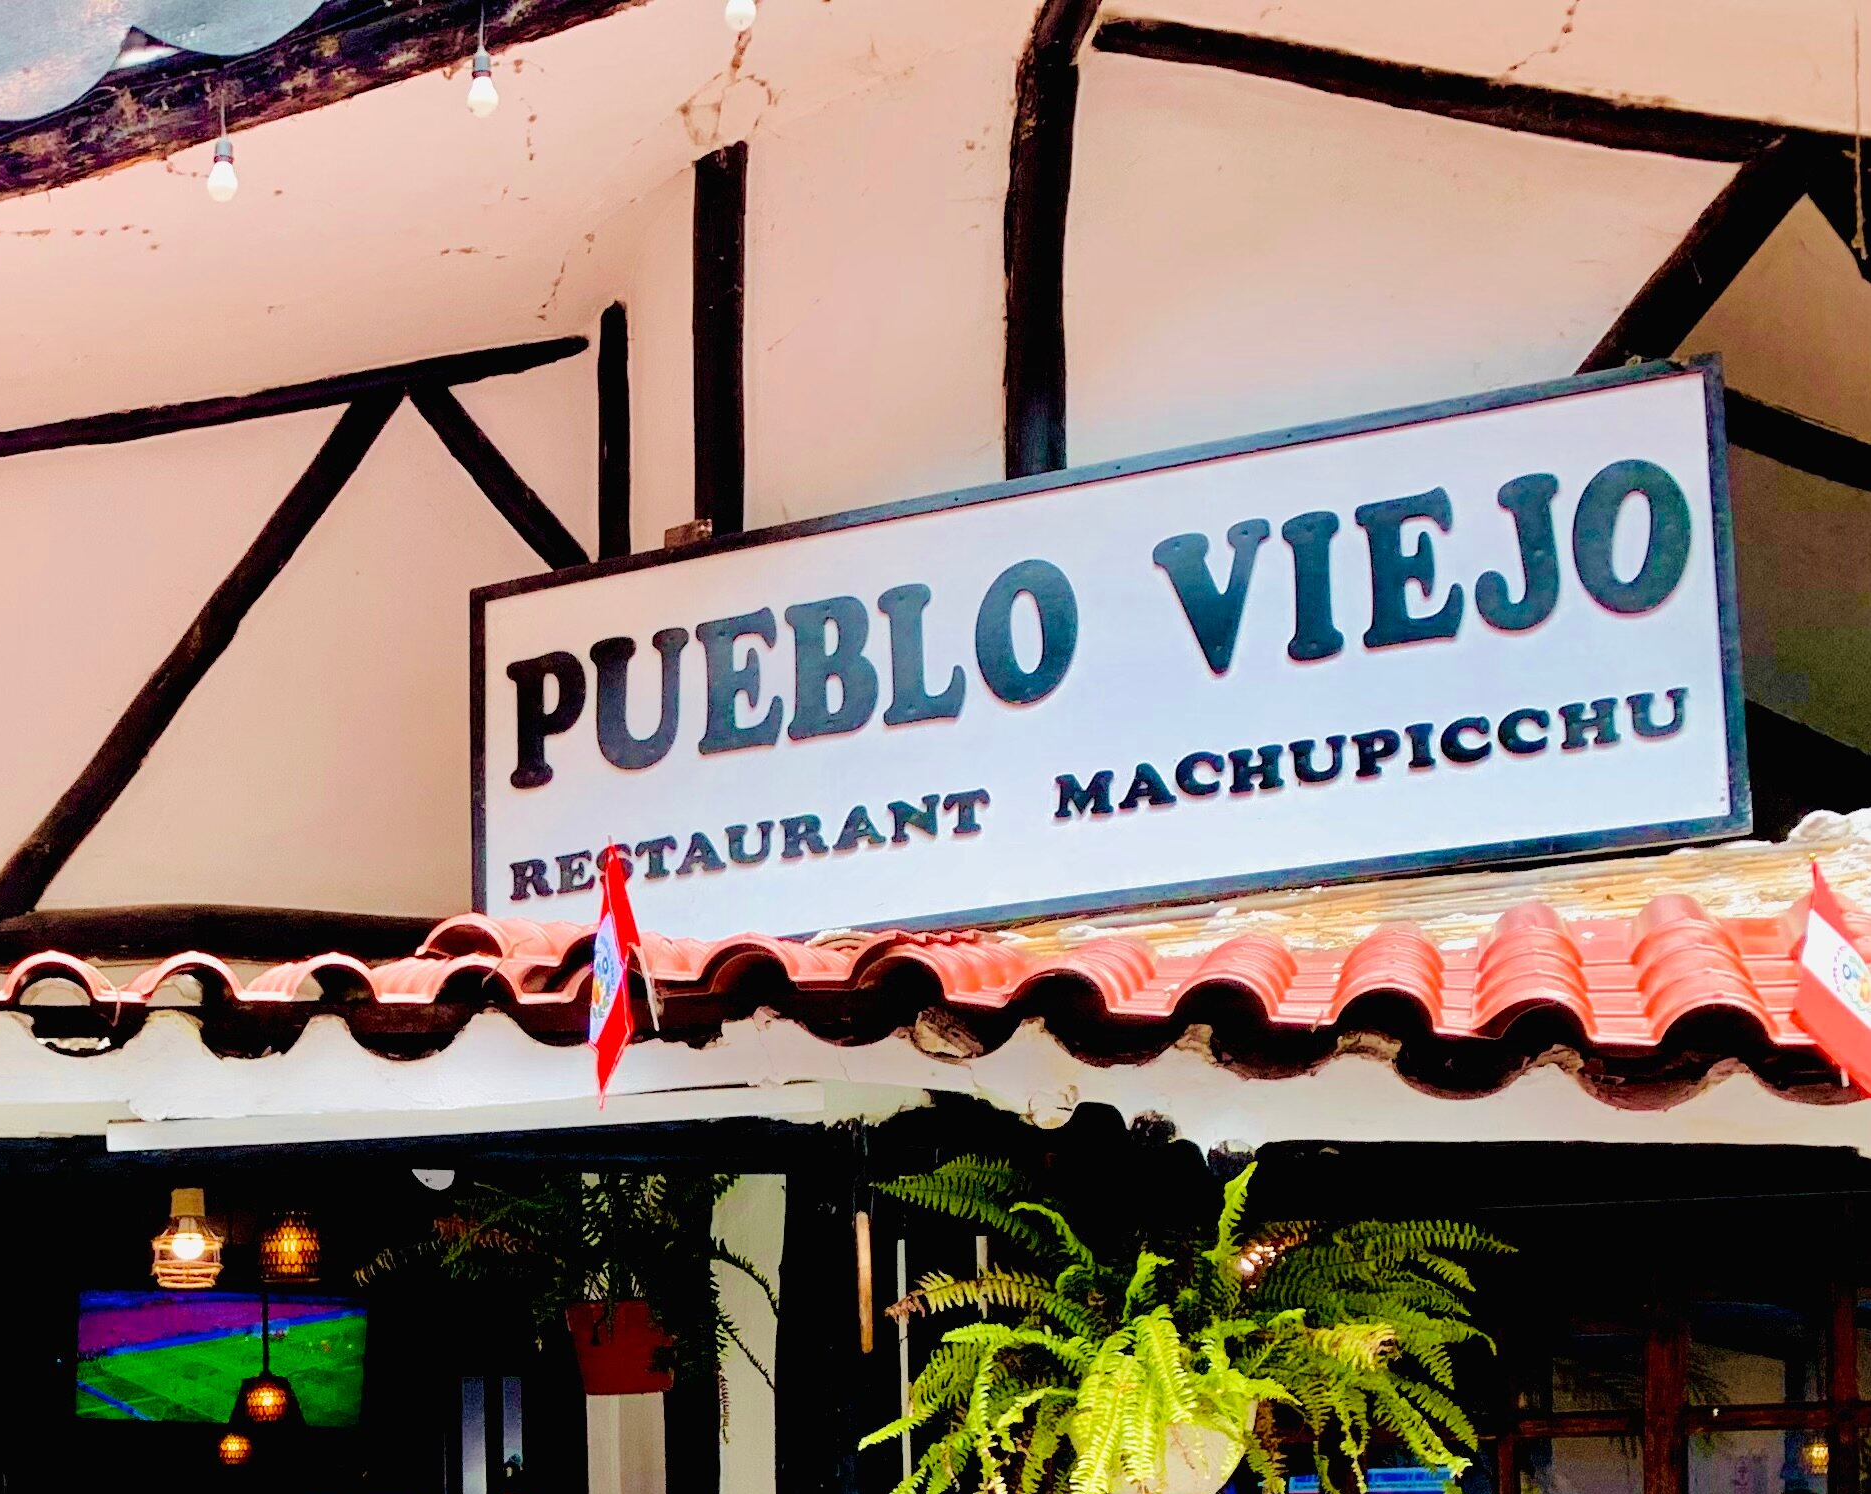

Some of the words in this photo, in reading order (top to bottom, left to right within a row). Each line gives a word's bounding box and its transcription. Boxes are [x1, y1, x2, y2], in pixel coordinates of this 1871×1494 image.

[508, 558, 1079, 790] PUEBLO
[1152, 457, 1692, 676] VIEJO
[510, 789, 990, 902] RESTAURANT
[1053, 687, 1691, 821] MACHUPICCHU
